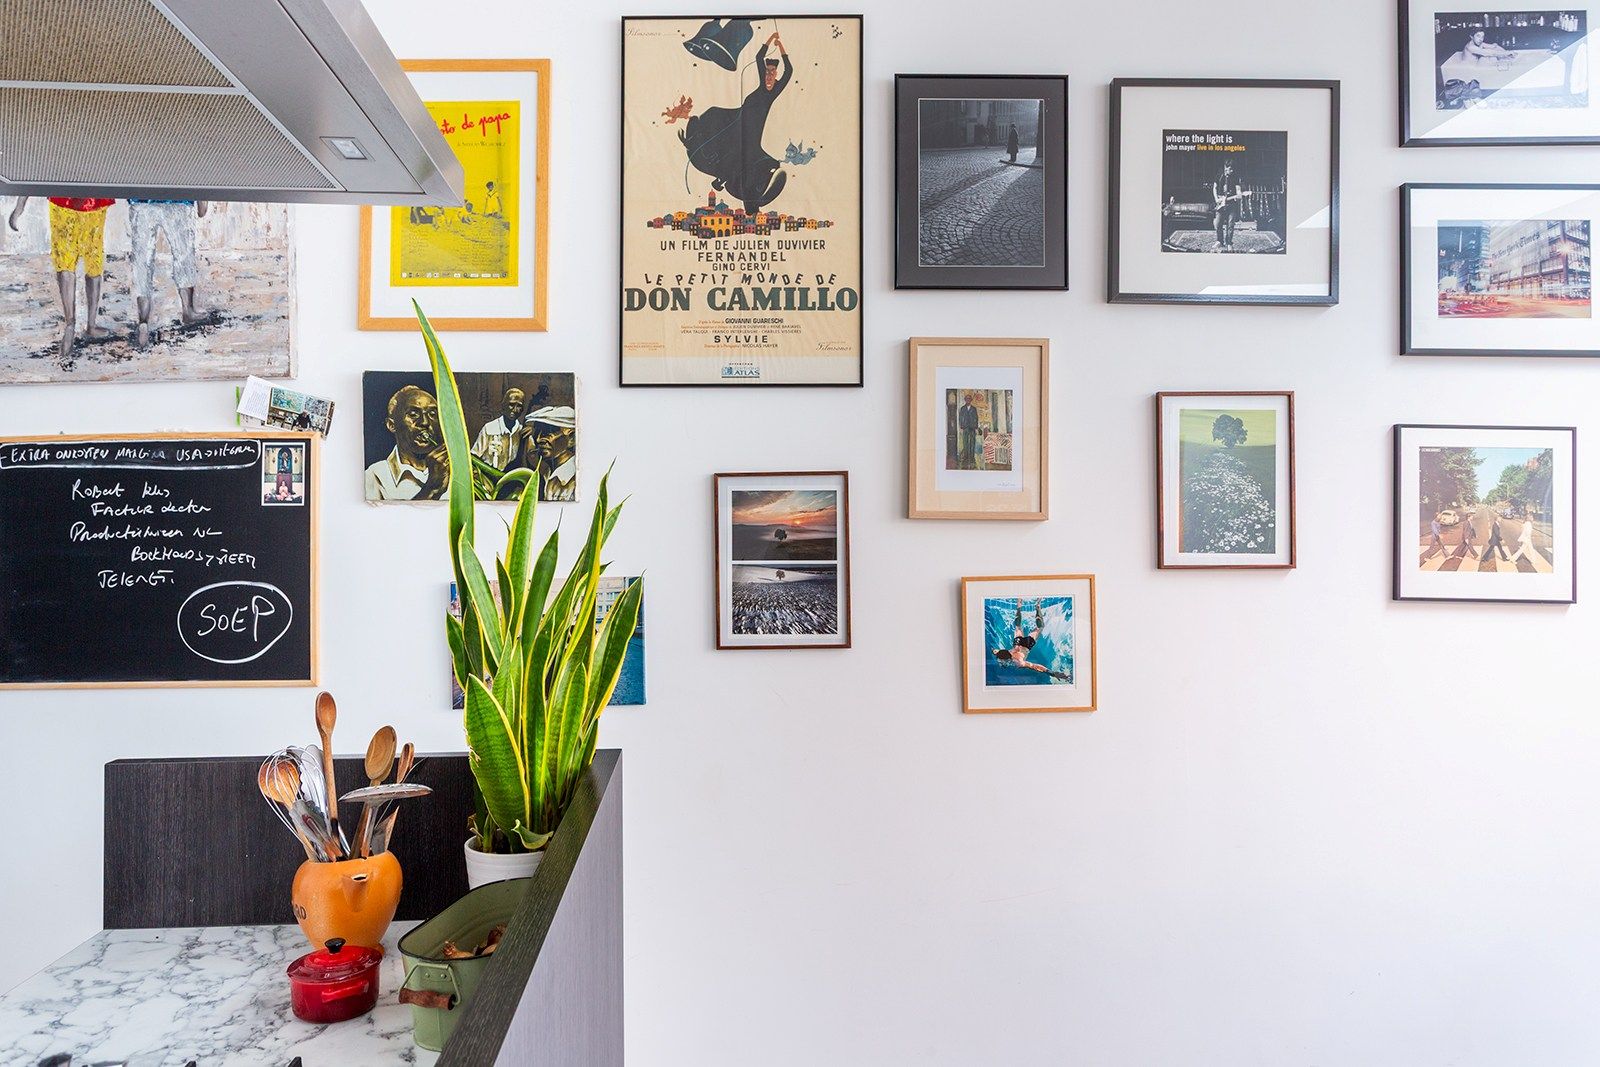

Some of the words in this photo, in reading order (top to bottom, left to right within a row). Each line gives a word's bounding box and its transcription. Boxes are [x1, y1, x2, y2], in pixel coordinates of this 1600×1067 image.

[461, 113, 475, 129] de
[479, 112, 511, 137] papa
[1165, 134, 1190, 143] where
[1191, 134, 1205, 143] the
[1206, 134, 1224, 145] light
[1225, 134, 1233, 143] is
[660, 240, 676, 250] UN
[682, 240, 708, 250] FILM
[714, 240, 728, 250] DE
[732, 240, 770, 250] JULIEN
[777, 240, 826, 250] DUVIVIER
[698, 251, 787, 262] FERNANDEL
[712, 263, 736, 271] GINO
[740, 263, 770, 271] CERVI
[644, 273, 664, 286] LE
[675, 273, 729, 286] PETIT
[741, 272, 804, 286] MONDE
[816, 273, 837, 286] DE
[624, 287, 692, 312] DON
[706, 287, 858, 312] CAMILLO
[714, 335, 768, 343] SYLVIE
[11, 447, 50, 463] EXTRA
